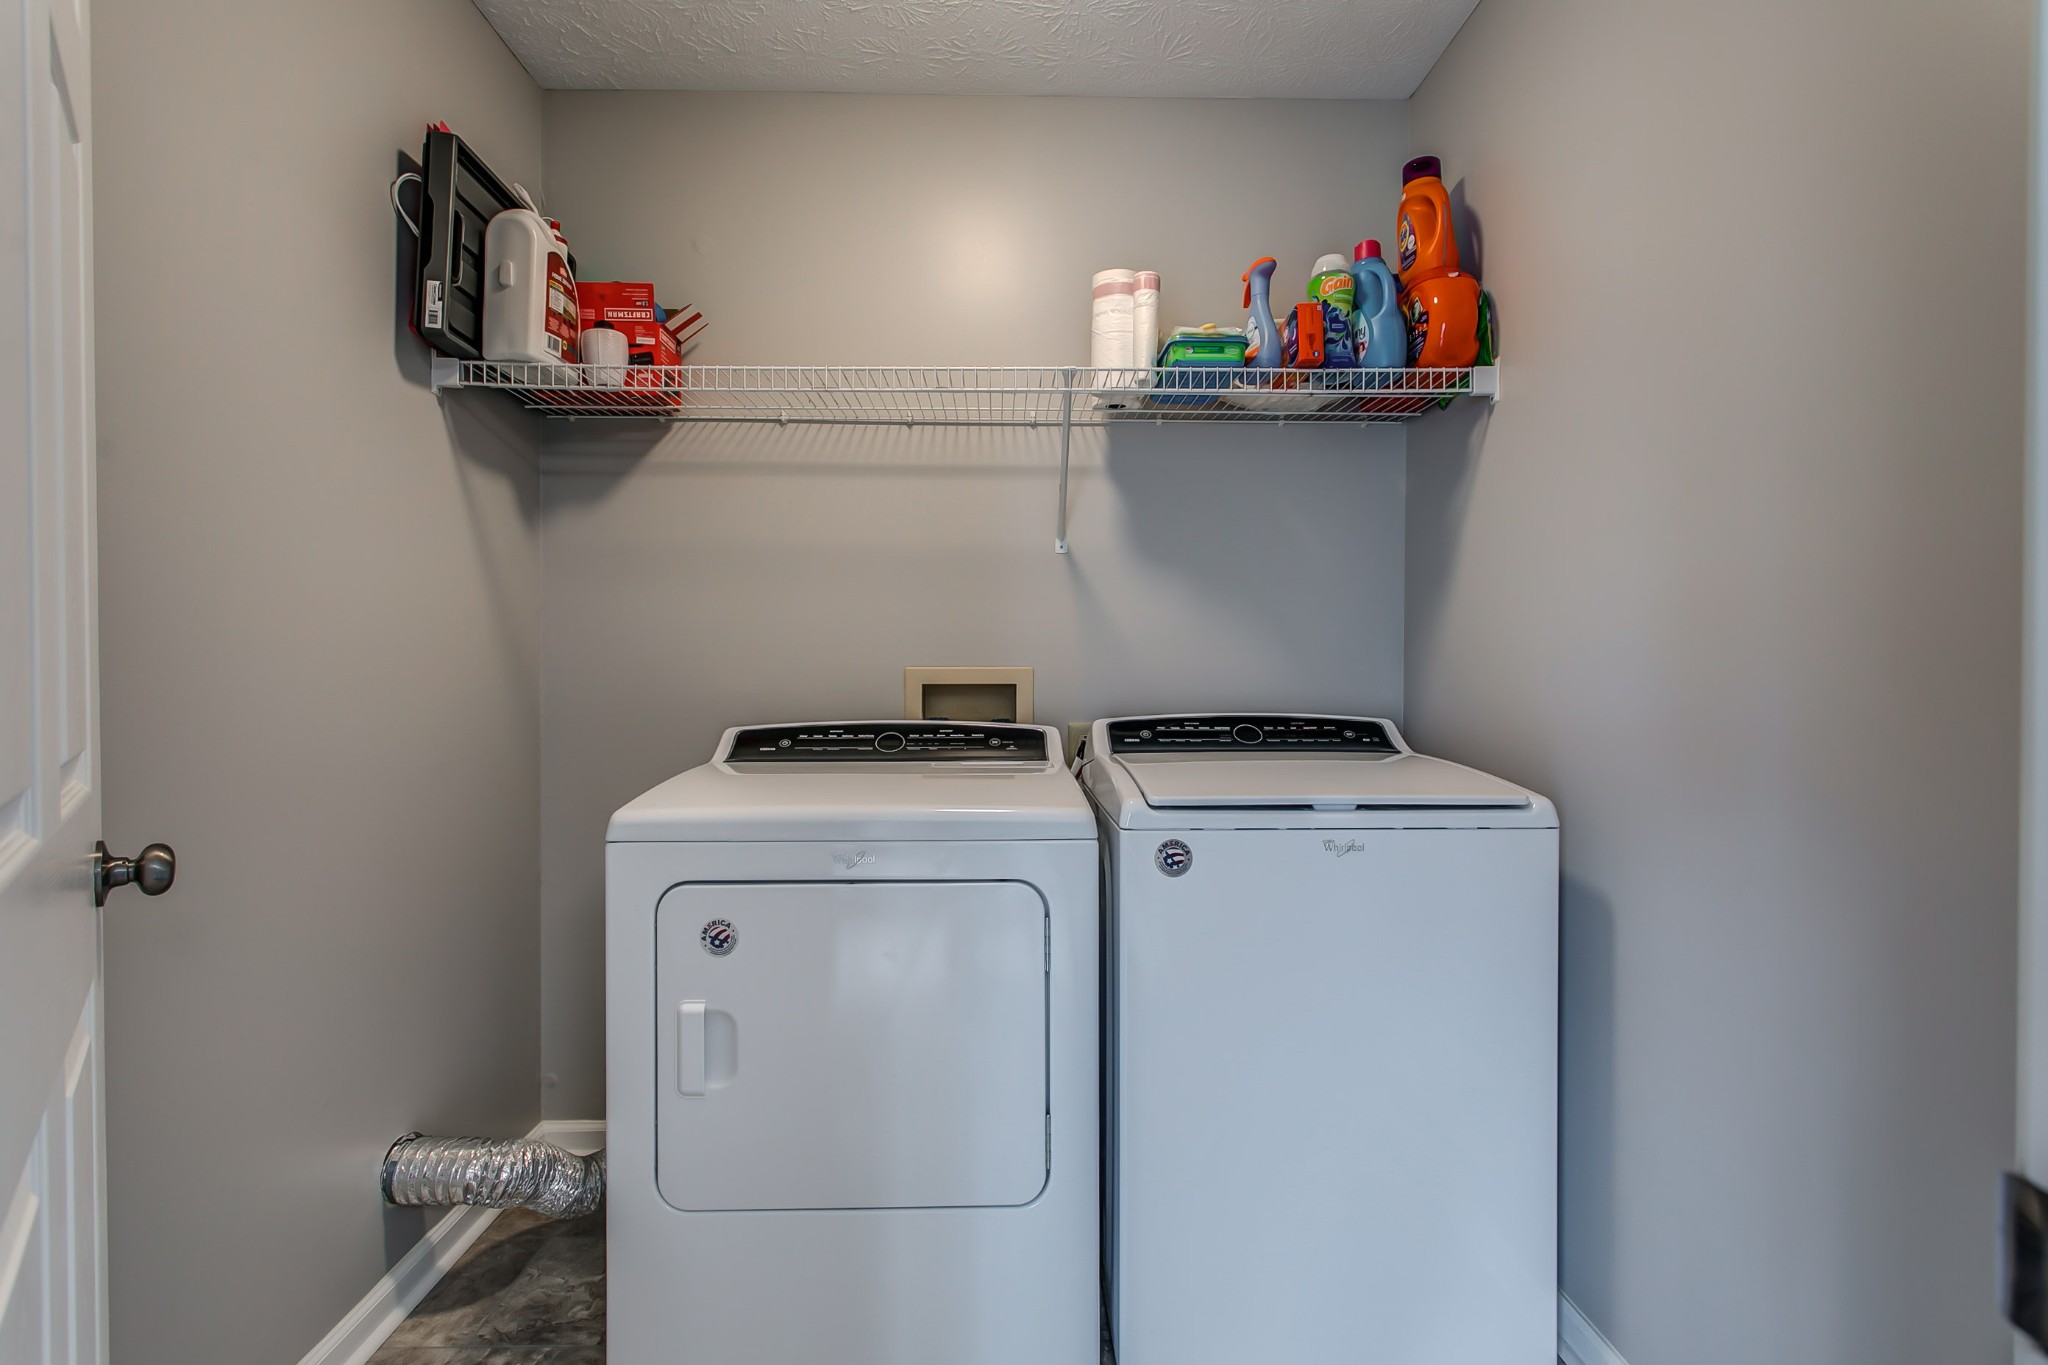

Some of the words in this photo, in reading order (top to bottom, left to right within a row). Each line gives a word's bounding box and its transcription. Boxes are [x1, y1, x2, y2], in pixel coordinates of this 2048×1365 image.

[1320, 275, 1354, 296] Gain
[607, 311, 651, 319] CRAFTSMAN
[1158, 840, 1190, 856] AMERICA
[1323, 841, 1365, 855] Whirlpool
[701, 919, 731, 941] AMERICA
